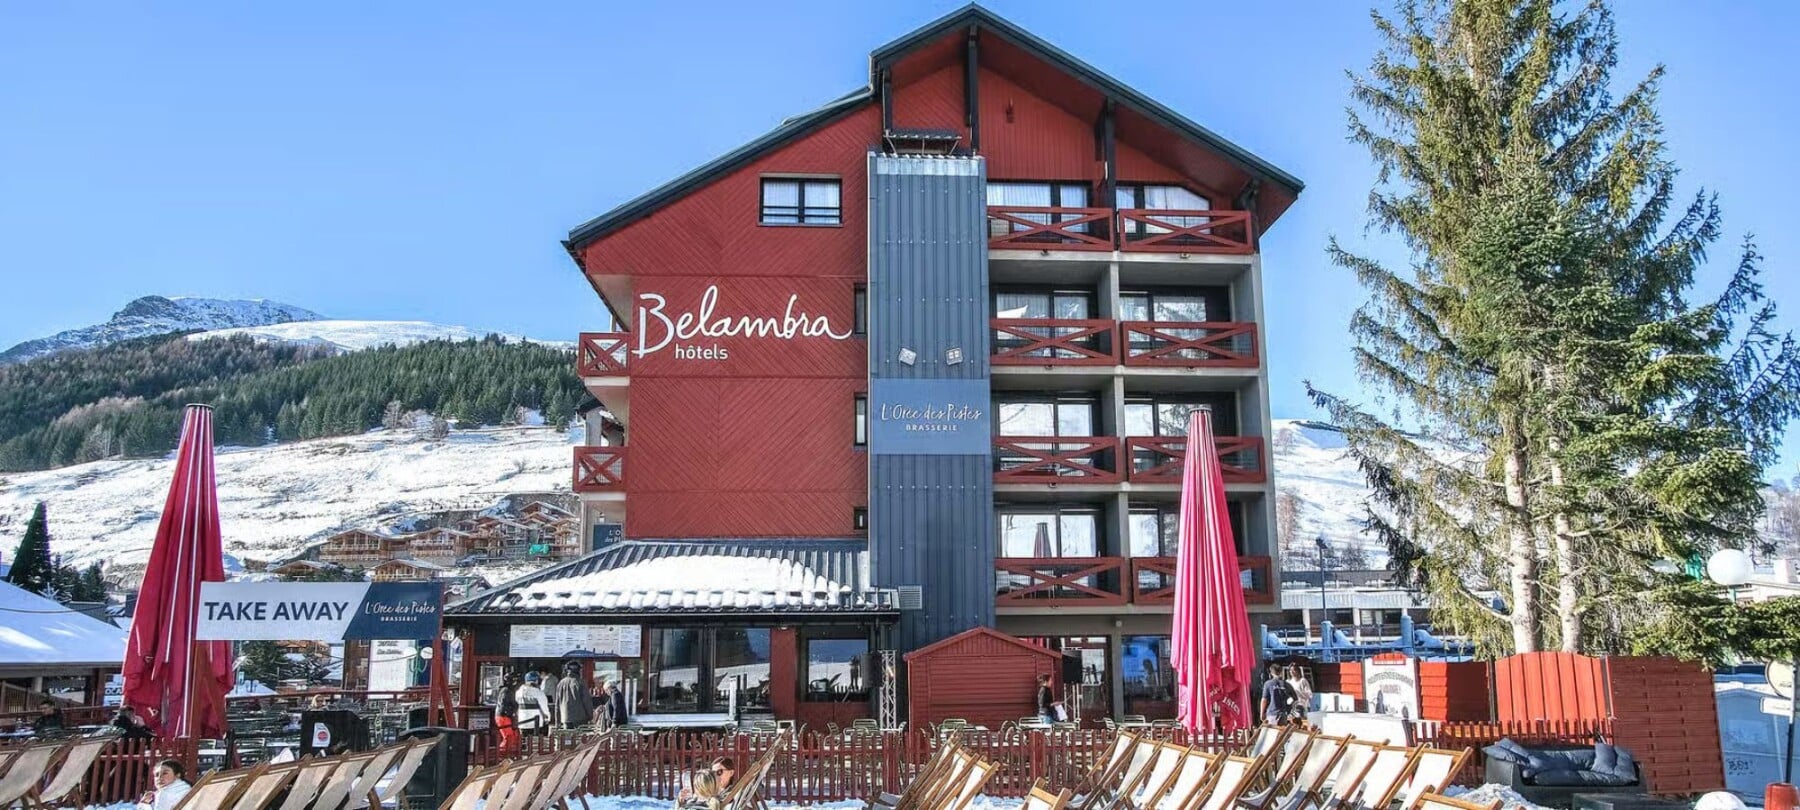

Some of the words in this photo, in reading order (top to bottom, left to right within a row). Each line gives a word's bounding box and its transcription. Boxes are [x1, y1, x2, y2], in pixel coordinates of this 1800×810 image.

[632, 285, 852, 359] Belambra
[674, 344, 728, 359] hôtels
[924, 403, 946, 420] des
[947, 403, 983, 421] Pistes
[905, 424, 958, 432] BRASSERIE
[204, 602, 267, 620] TAKE
[272, 602, 349, 620] AWAY
[395, 601, 409, 614] des
[411, 601, 436, 615] Pistes
